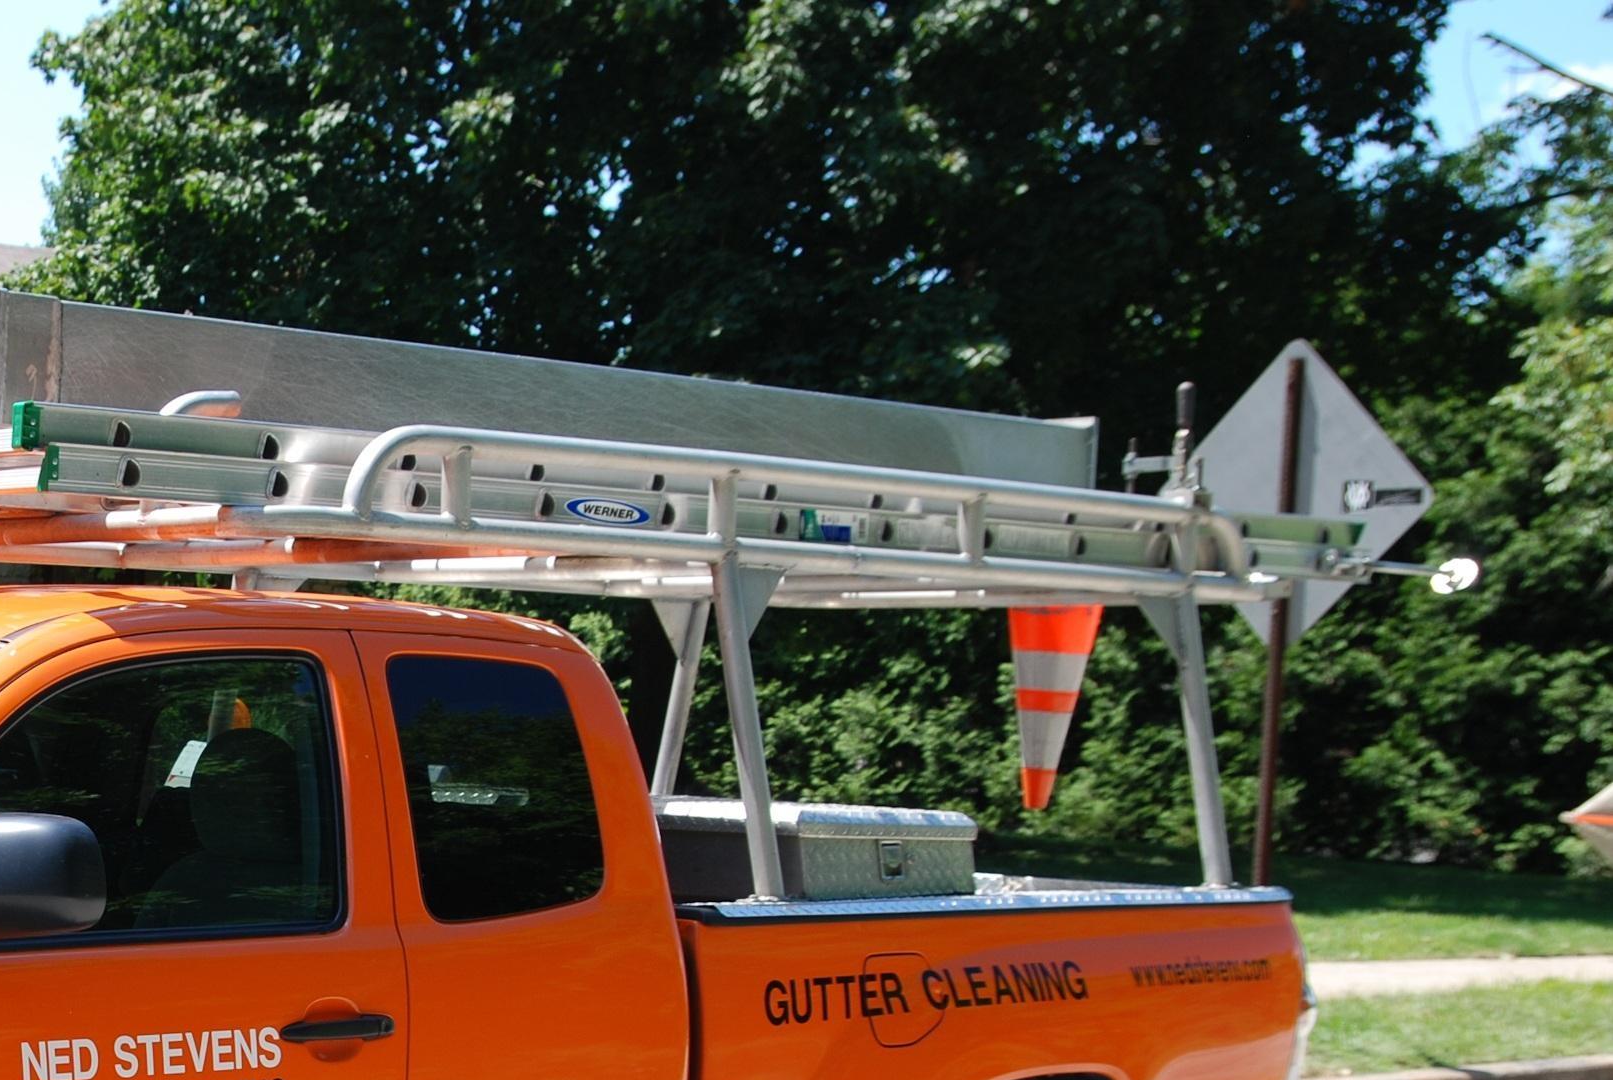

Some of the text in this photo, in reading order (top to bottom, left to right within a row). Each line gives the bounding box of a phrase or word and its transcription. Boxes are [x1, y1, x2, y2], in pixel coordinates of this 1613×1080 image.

[582, 503, 635, 520] WERNER
[763, 960, 1090, 1027] GUTTER CLEANING
[113, 1026, 283, 1078] STEVENS
